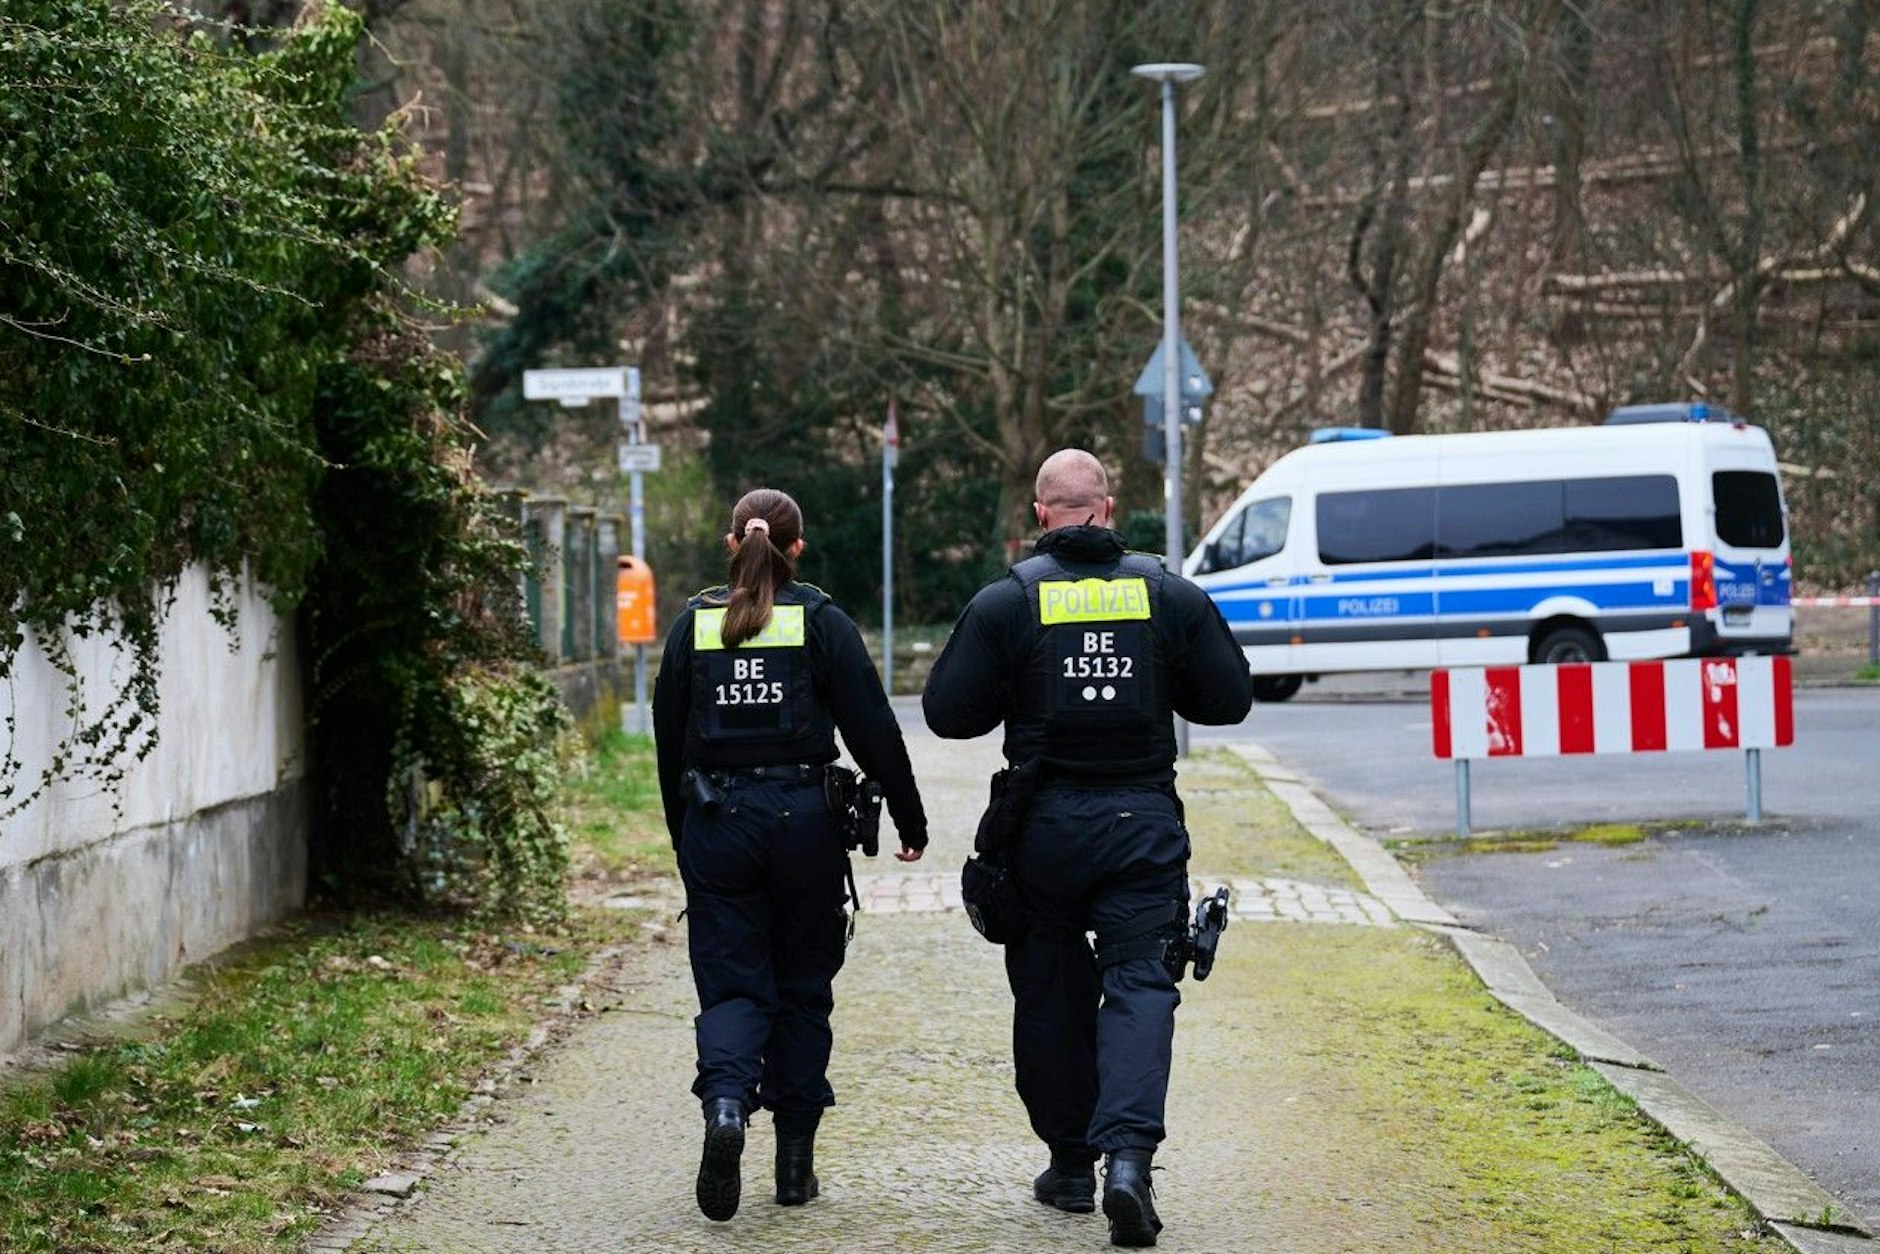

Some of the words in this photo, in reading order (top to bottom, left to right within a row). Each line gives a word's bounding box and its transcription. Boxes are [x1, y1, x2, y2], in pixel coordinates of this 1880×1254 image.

[1046, 585, 1144, 616] POLIZEI
[1338, 598, 1399, 615] POLIZEI
[1083, 632, 1115, 653] BE
[733, 658, 765, 680] BE
[1063, 656, 1133, 678] 15132
[716, 682, 784, 705] 15125
